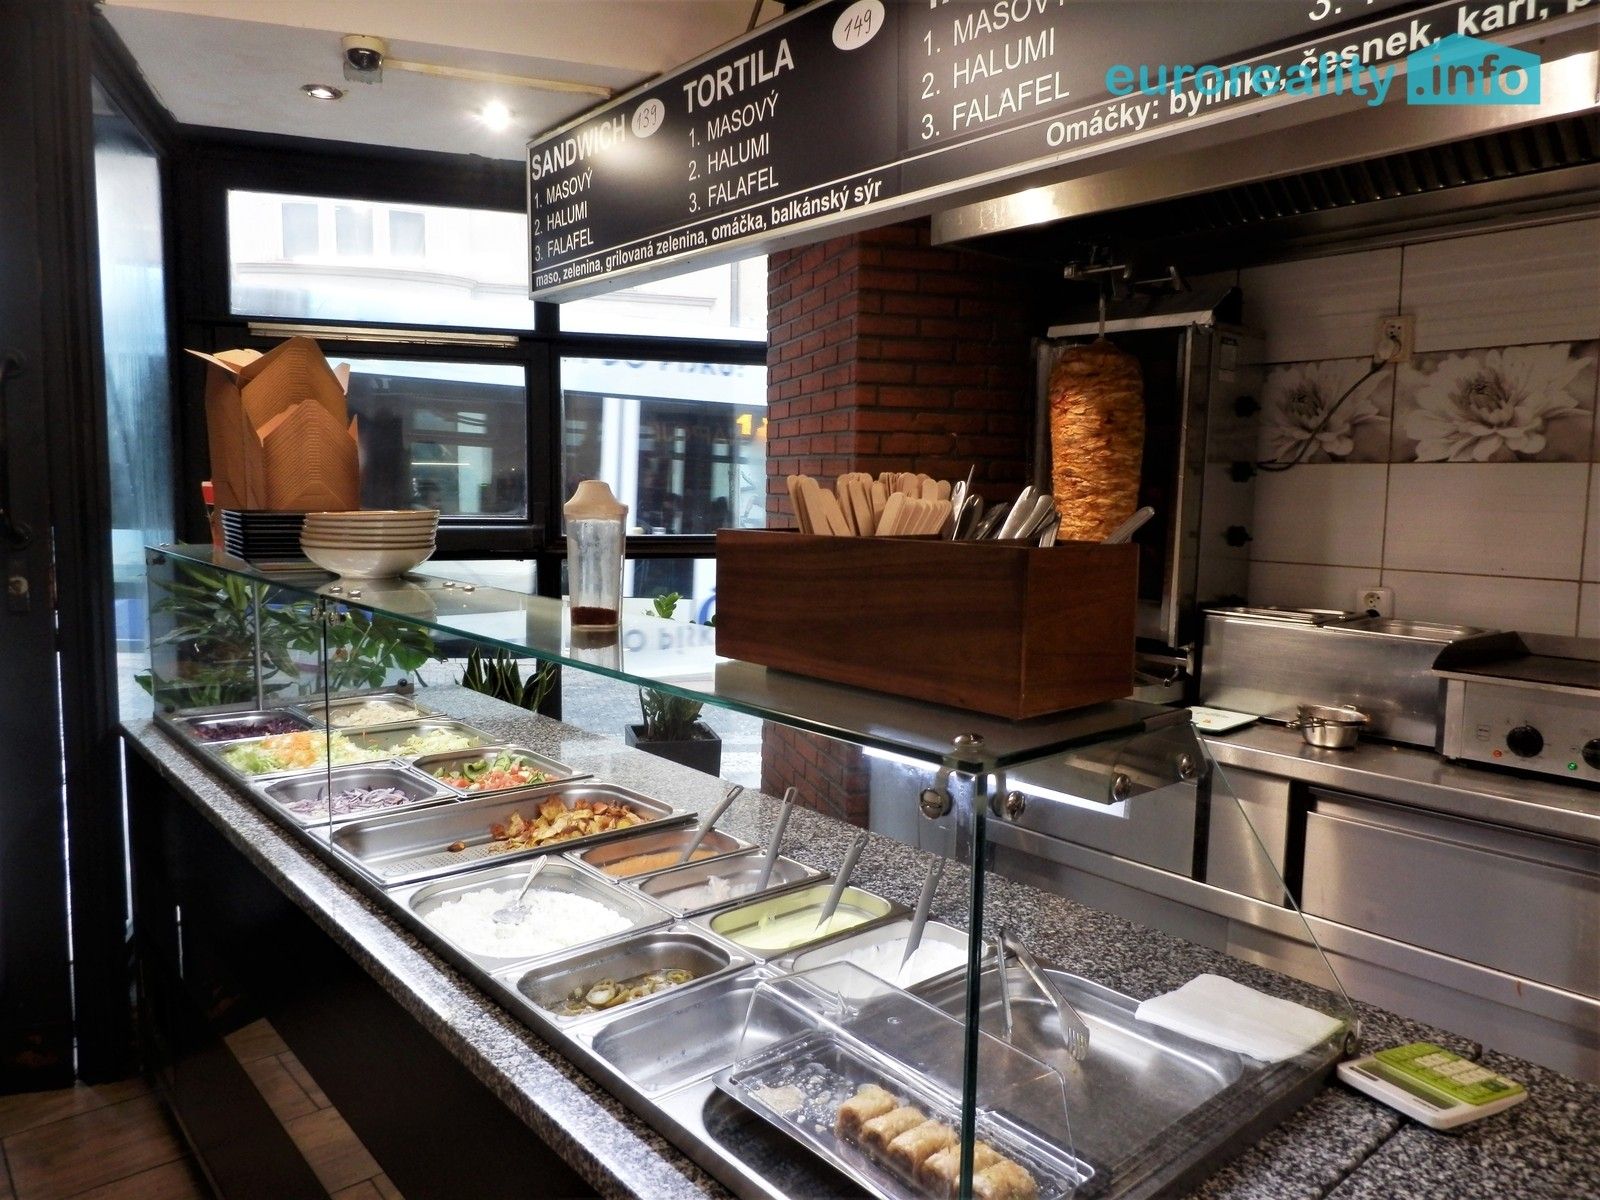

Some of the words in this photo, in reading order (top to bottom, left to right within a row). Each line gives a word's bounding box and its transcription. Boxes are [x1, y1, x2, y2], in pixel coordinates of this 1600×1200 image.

[844, 9, 872, 41] 149
[923, 30, 941, 56] 1.
[954, 0, 1065, 46] MASOV
[683, 38, 795, 114] TORTILA
[921, 72, 940, 100] 2.
[953, 27, 1055, 89] HALUMI
[1046, 100, 1159, 147] Omáčky:
[1299, 20, 1441, 79] česnek,
[637, 104, 657, 130] 139
[689, 128, 700, 148] 1.
[707, 89, 779, 142] MASOVÝ
[921, 113, 940, 140] 3.
[953, 71, 1070, 131] FALAFEL
[532, 113, 626, 180] SANDWICH
[688, 160, 700, 181] 2.
[707, 132, 769, 174] HALUMI
[534, 193, 542, 209] 1.
[546, 167, 593, 205] MASOVÝ
[688, 192, 700, 213] 3.
[708, 166, 779, 207] FALAFEL
[534, 219, 543, 236] 2.
[546, 201, 588, 232] HALUMI
[534, 245, 543, 262] 3.
[547, 228, 594, 258] FALAFEL
[535, 271, 561, 287] maso,
[562, 259, 603, 281] zelenina,
[605, 241, 653, 272] grilovaná
[656, 230, 708, 255] zelenina,
[711, 213, 767, 241] omáčka,
[771, 185, 849, 225] balkánský
[854, 178, 882, 205] sýr
